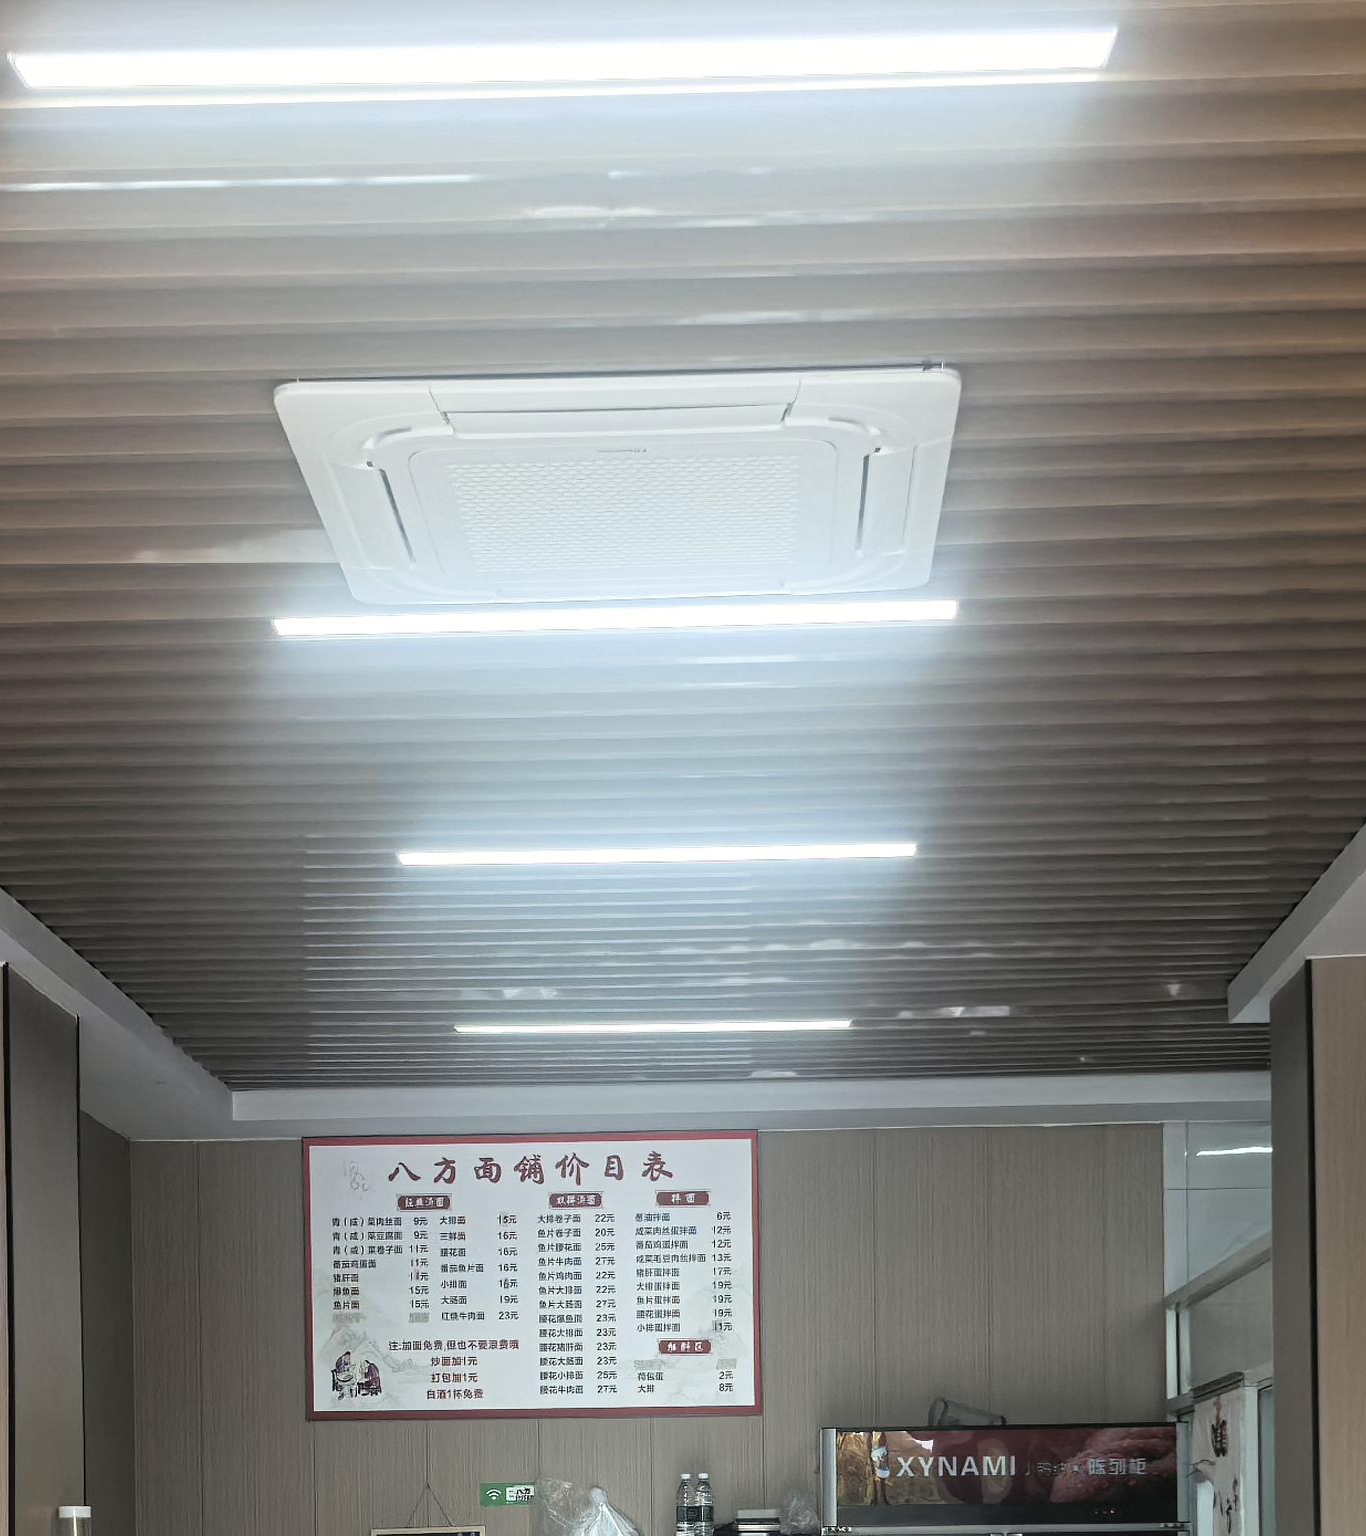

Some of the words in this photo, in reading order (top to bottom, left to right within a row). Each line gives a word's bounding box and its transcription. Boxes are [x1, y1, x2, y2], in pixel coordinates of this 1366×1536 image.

[388, 1149, 673, 1186] 八方面铺价目表
[439, 1216, 466, 1225] 大排面
[595, 1214, 615, 1222] 22元
[717, 1212, 731, 1220] 6元
[414, 1217, 428, 1226] 9元
[595, 1228, 615, 1237] 20元
[712, 1225, 731, 1234] 12元
[414, 1231, 428, 1240] 9元
[440, 1232, 466, 1241] 三鲜面
[498, 1231, 517, 1240] 16元
[595, 1243, 615, 1252] 25元
[712, 1239, 731, 1248] 12元
[409, 1244, 428, 1253] 11元
[498, 1247, 517, 1256] 16元
[538, 1257, 582, 1266] 鱼片牛肉面
[595, 1257, 615, 1266] 27元
[712, 1253, 731, 1262] 13元
[498, 1264, 518, 1272] 16元
[713, 1267, 732, 1275] 17元
[595, 1271, 616, 1280] 22元
[596, 1285, 616, 1294] 22元
[713, 1281, 732, 1290] 19元
[409, 1286, 429, 1295] 15元
[499, 1295, 518, 1304] 19元
[596, 1299, 616, 1308] 27元
[713, 1295, 732, 1303] 19元
[333, 1300, 360, 1309] 鱼片面
[410, 1300, 429, 1309] 15元
[498, 1311, 519, 1320] 23元
[713, 1309, 732, 1317] 19元
[596, 1314, 616, 1322] 23元
[596, 1328, 616, 1337] 23元
[596, 1342, 617, 1351] 23元
[597, 1356, 617, 1365] 23元
[597, 1370, 617, 1380] 25元
[719, 1371, 734, 1380] 2元
[597, 1385, 617, 1394] 27元
[637, 1384, 655, 1393] 大排
[719, 1383, 734, 1392] 8元
[896, 1455, 1016, 1477] XYNAMI
